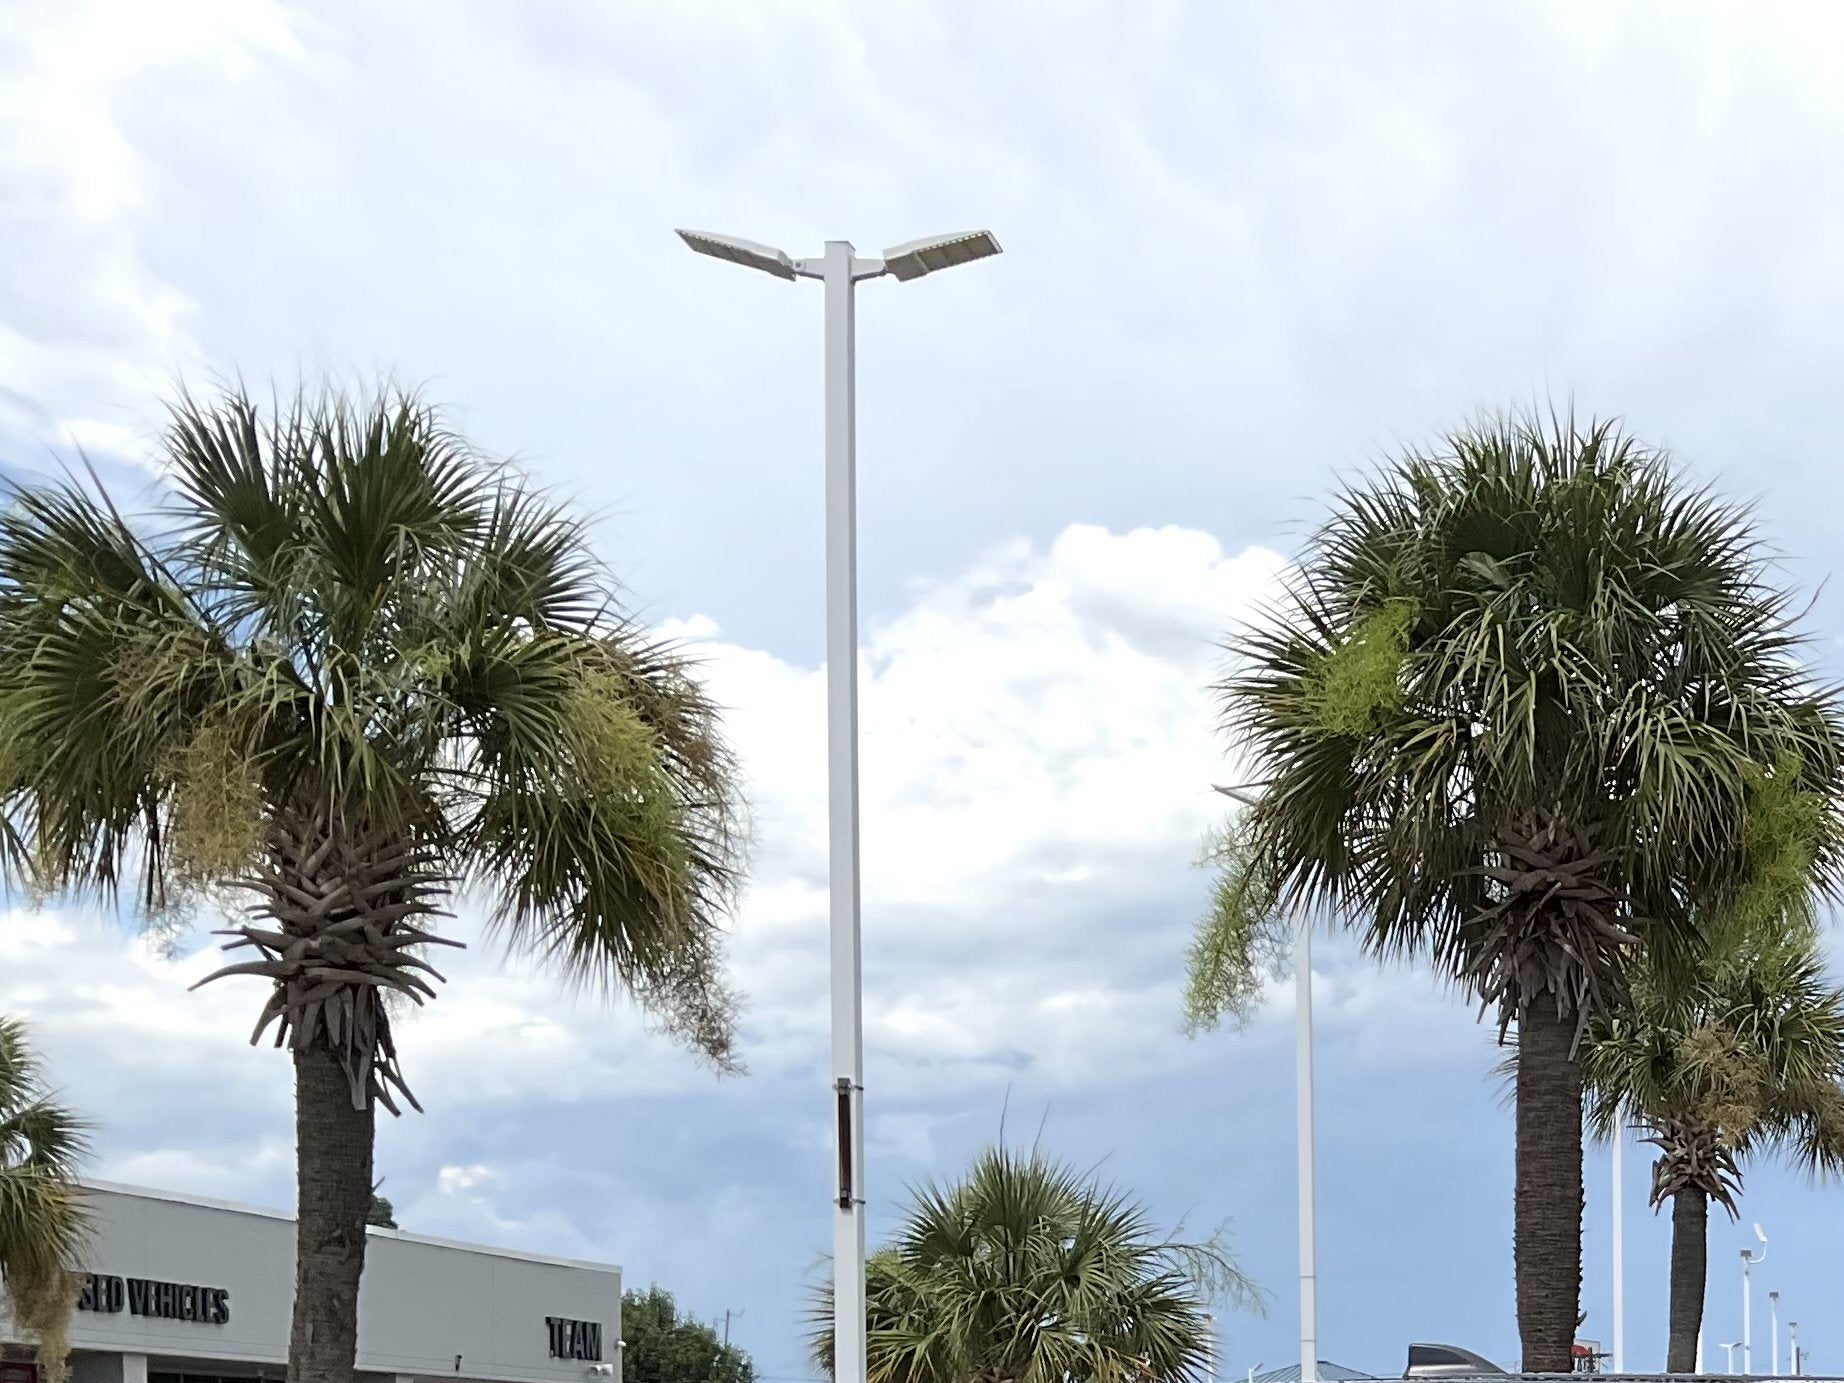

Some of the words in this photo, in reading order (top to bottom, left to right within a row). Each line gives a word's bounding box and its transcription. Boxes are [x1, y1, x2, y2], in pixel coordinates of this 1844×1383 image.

[66, 1271, 125, 1313] SED
[127, 1277, 230, 1325] VEHICLES
[545, 1316, 603, 1361] TEAM
